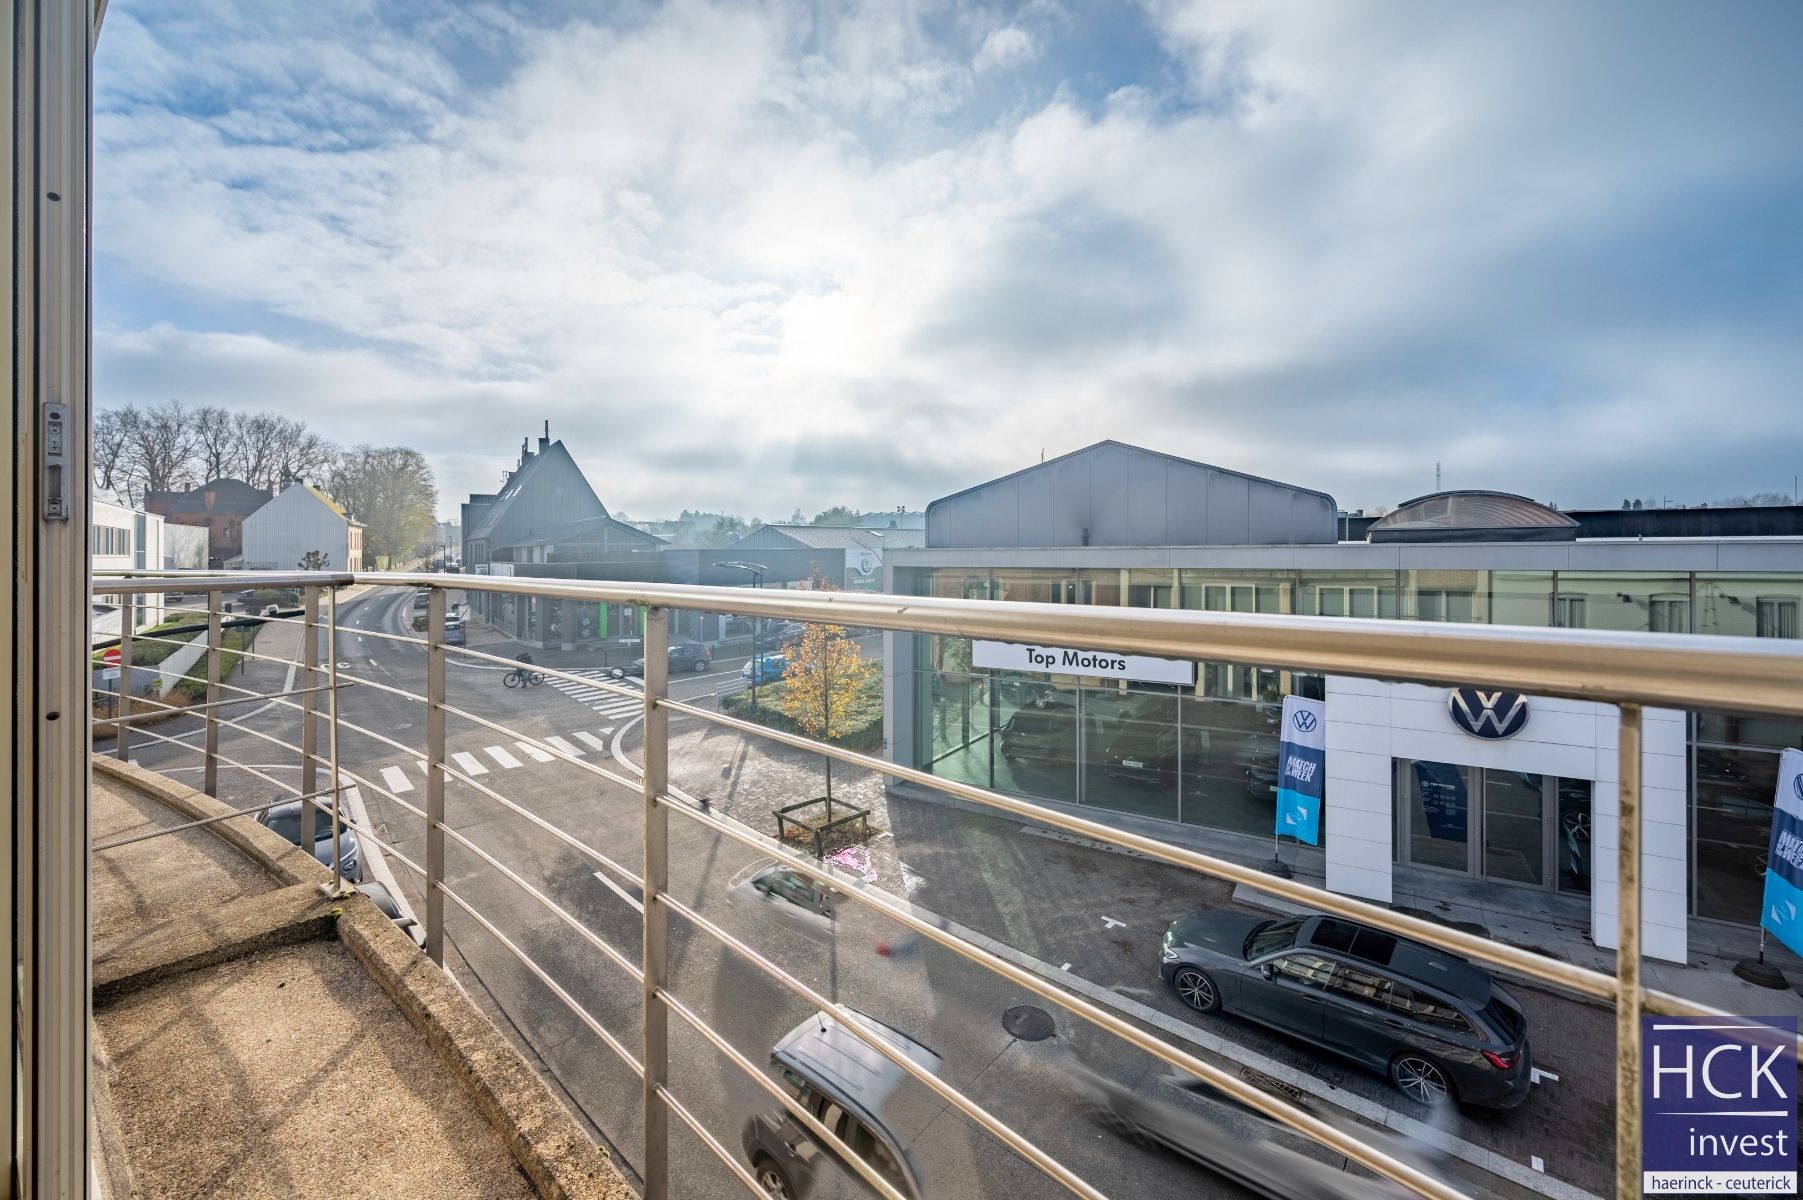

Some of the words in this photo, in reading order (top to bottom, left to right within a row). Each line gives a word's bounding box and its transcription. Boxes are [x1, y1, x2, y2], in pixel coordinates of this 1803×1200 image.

[1026, 648, 1056, 668] Top
[1062, 650, 1126, 670] Motors
[1286, 756, 1317, 772] MATCH
[1291, 766, 1314, 782] WEEK
